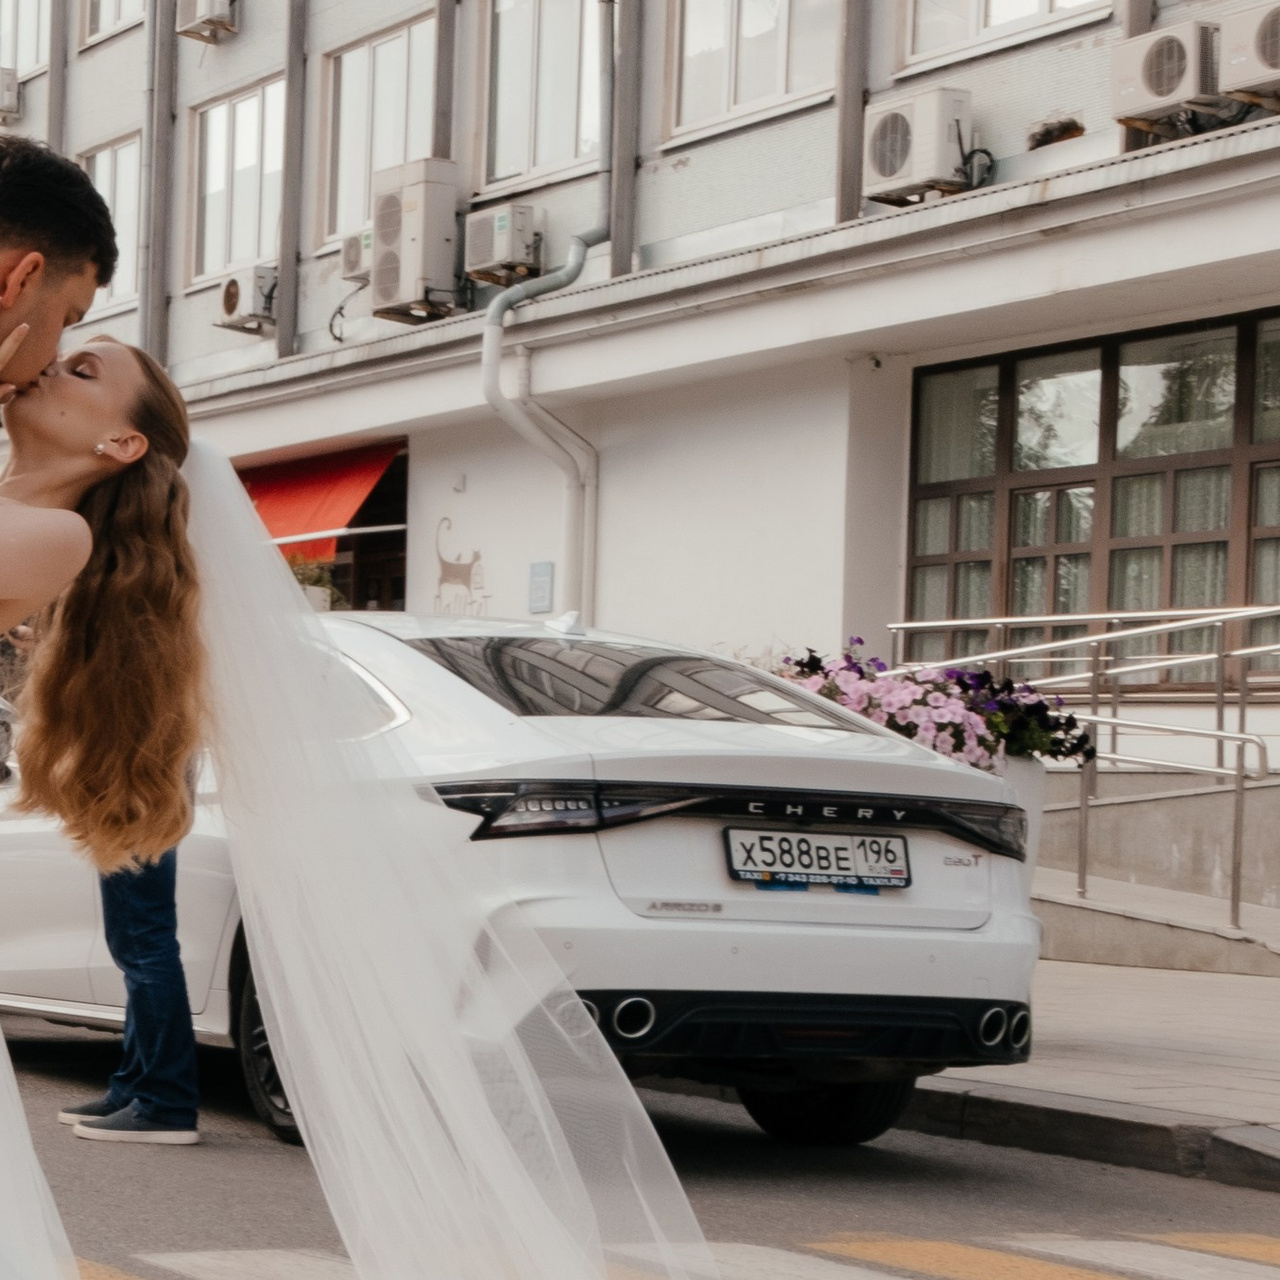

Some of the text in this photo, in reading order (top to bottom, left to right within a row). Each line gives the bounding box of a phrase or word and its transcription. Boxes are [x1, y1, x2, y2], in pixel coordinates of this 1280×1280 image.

[748, 802, 906, 820] CHERY
[857, 839, 897, 864] 196
[869, 864, 889, 875] RUS
